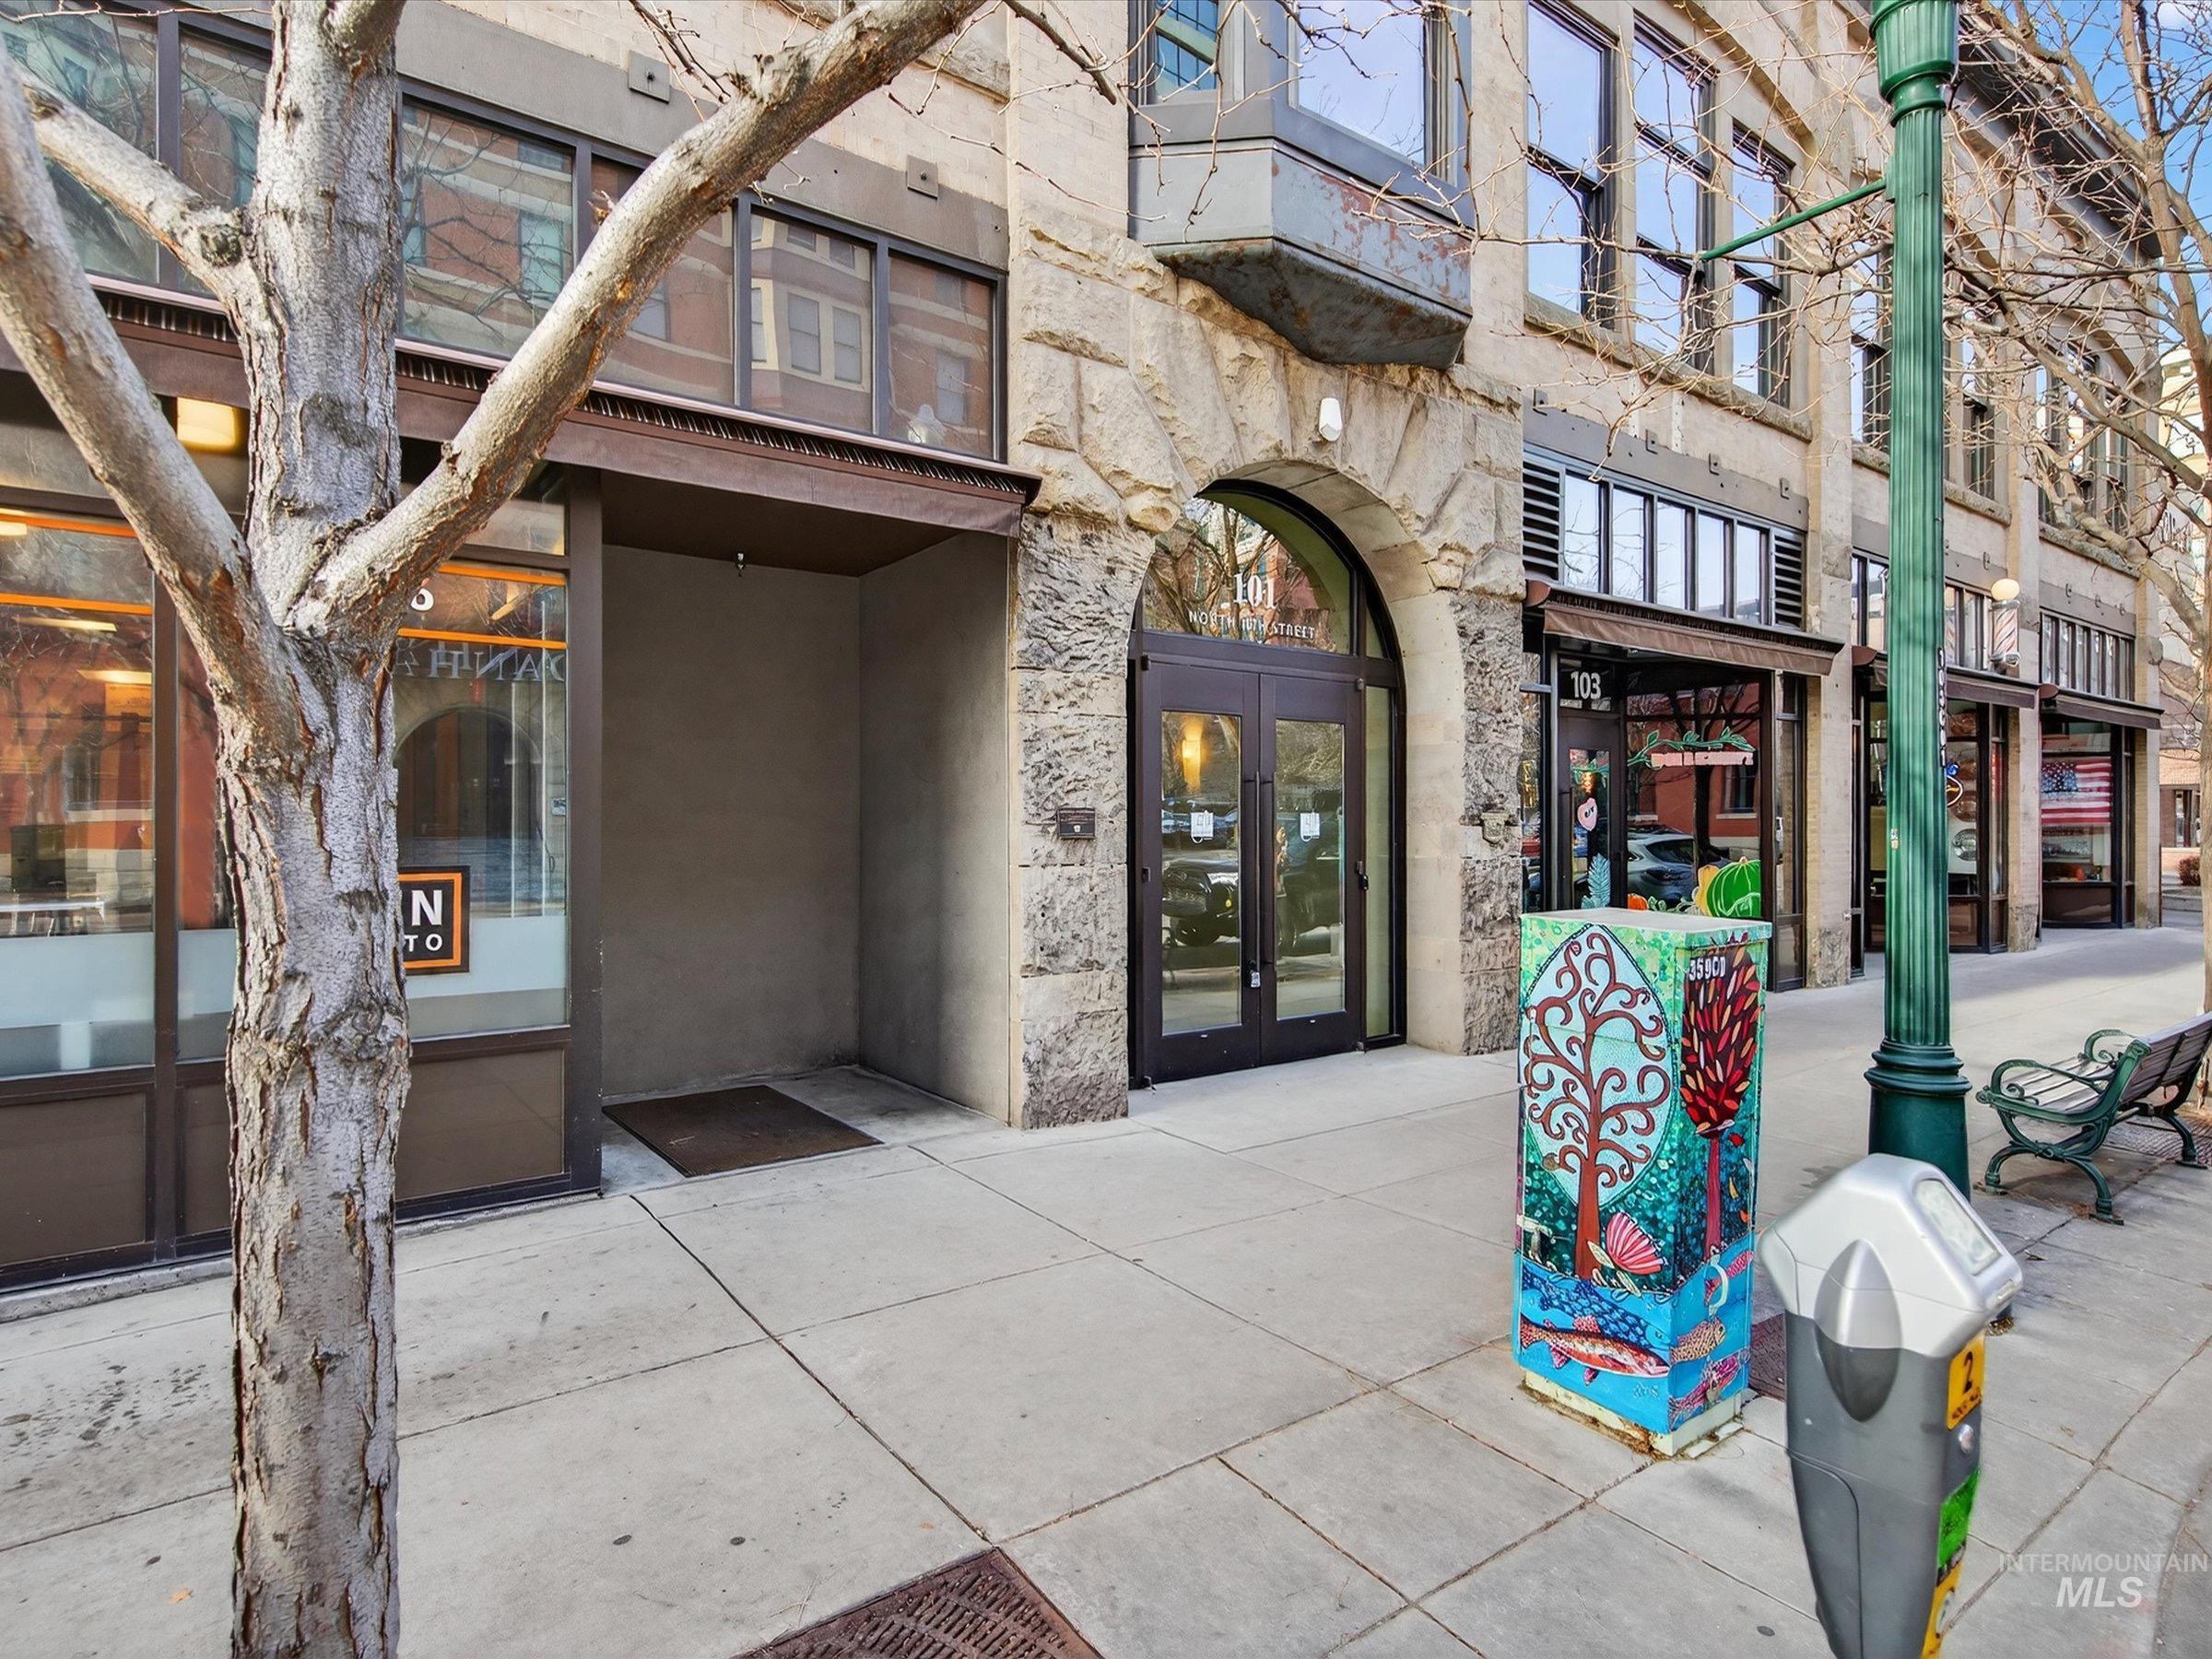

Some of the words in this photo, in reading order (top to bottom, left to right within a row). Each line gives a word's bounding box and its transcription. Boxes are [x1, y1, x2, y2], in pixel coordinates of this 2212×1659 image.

[1234, 572, 1276, 608] 101
[1188, 610, 1236, 628] NORTH
[1271, 622, 1315, 641] STREET
[1571, 670, 1601, 700] 103
[1963, 1351, 1973, 1394] 2
